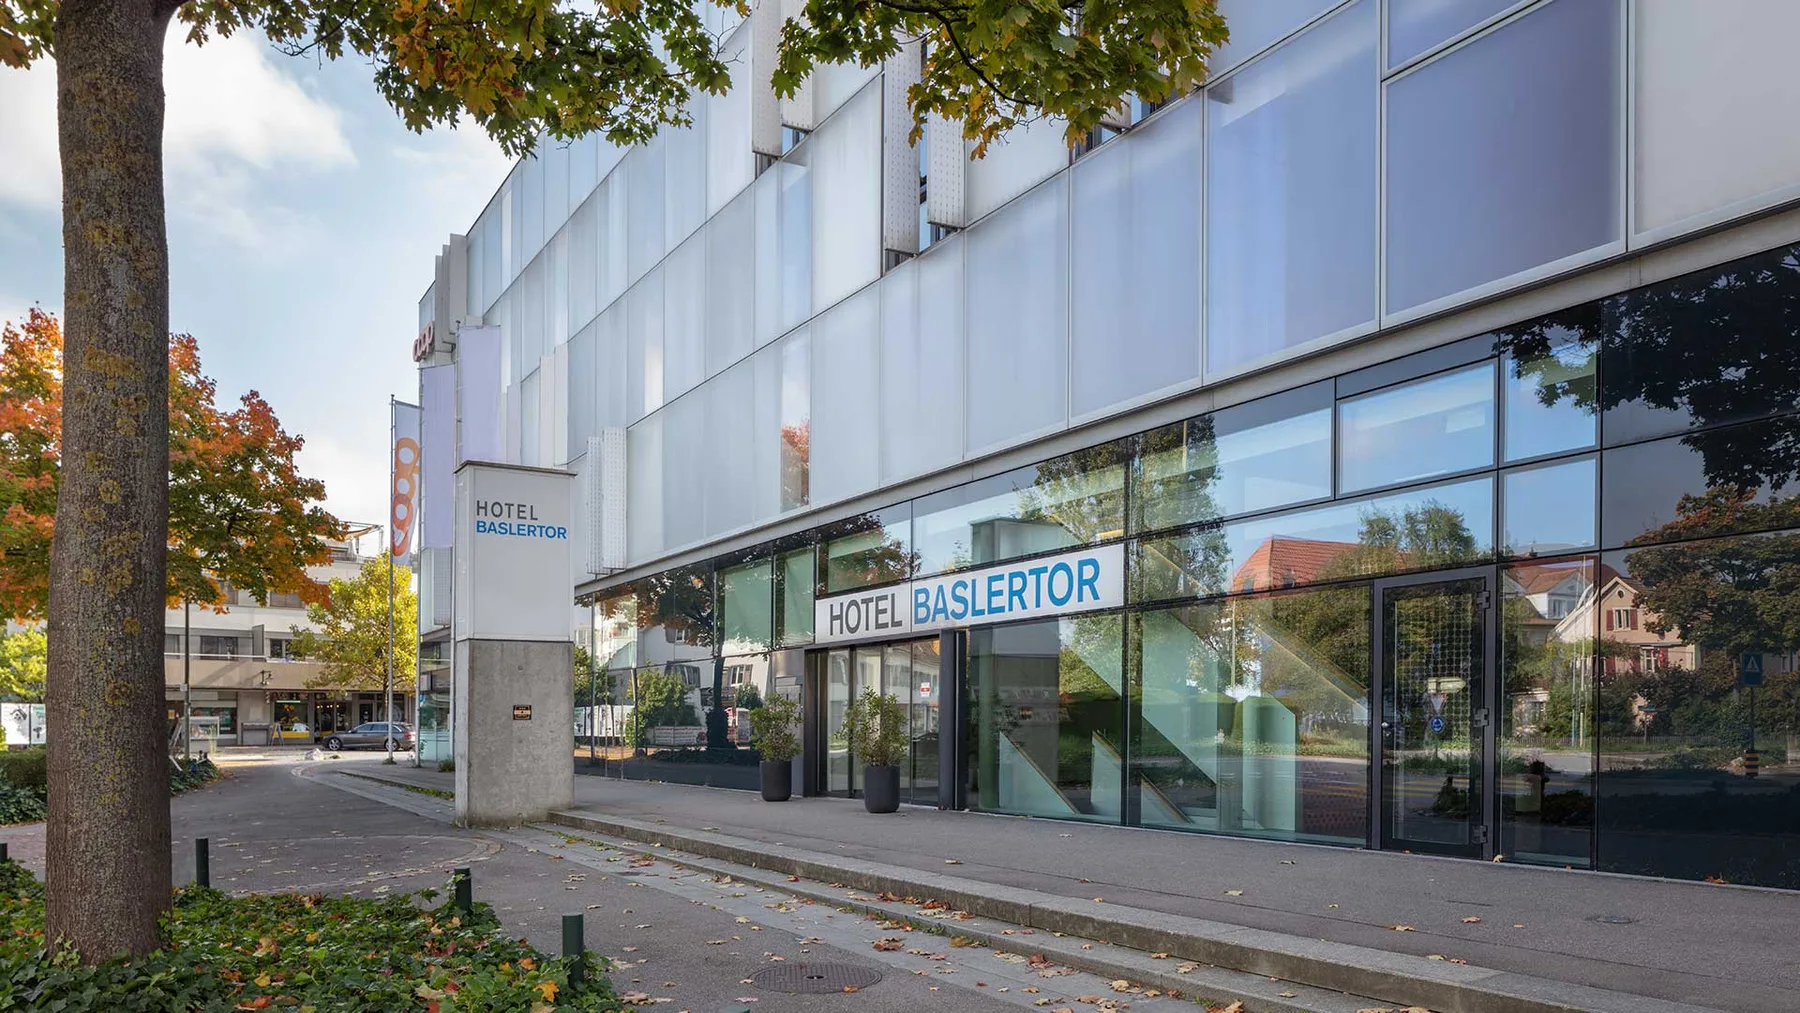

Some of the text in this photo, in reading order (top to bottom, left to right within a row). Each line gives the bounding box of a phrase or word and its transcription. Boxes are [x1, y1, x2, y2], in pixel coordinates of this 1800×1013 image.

[476, 499, 539, 521] HOTEL
[476, 520, 567, 540] BASLERTOR
[829, 557, 1101, 636] HOTEL BASLERTOR
